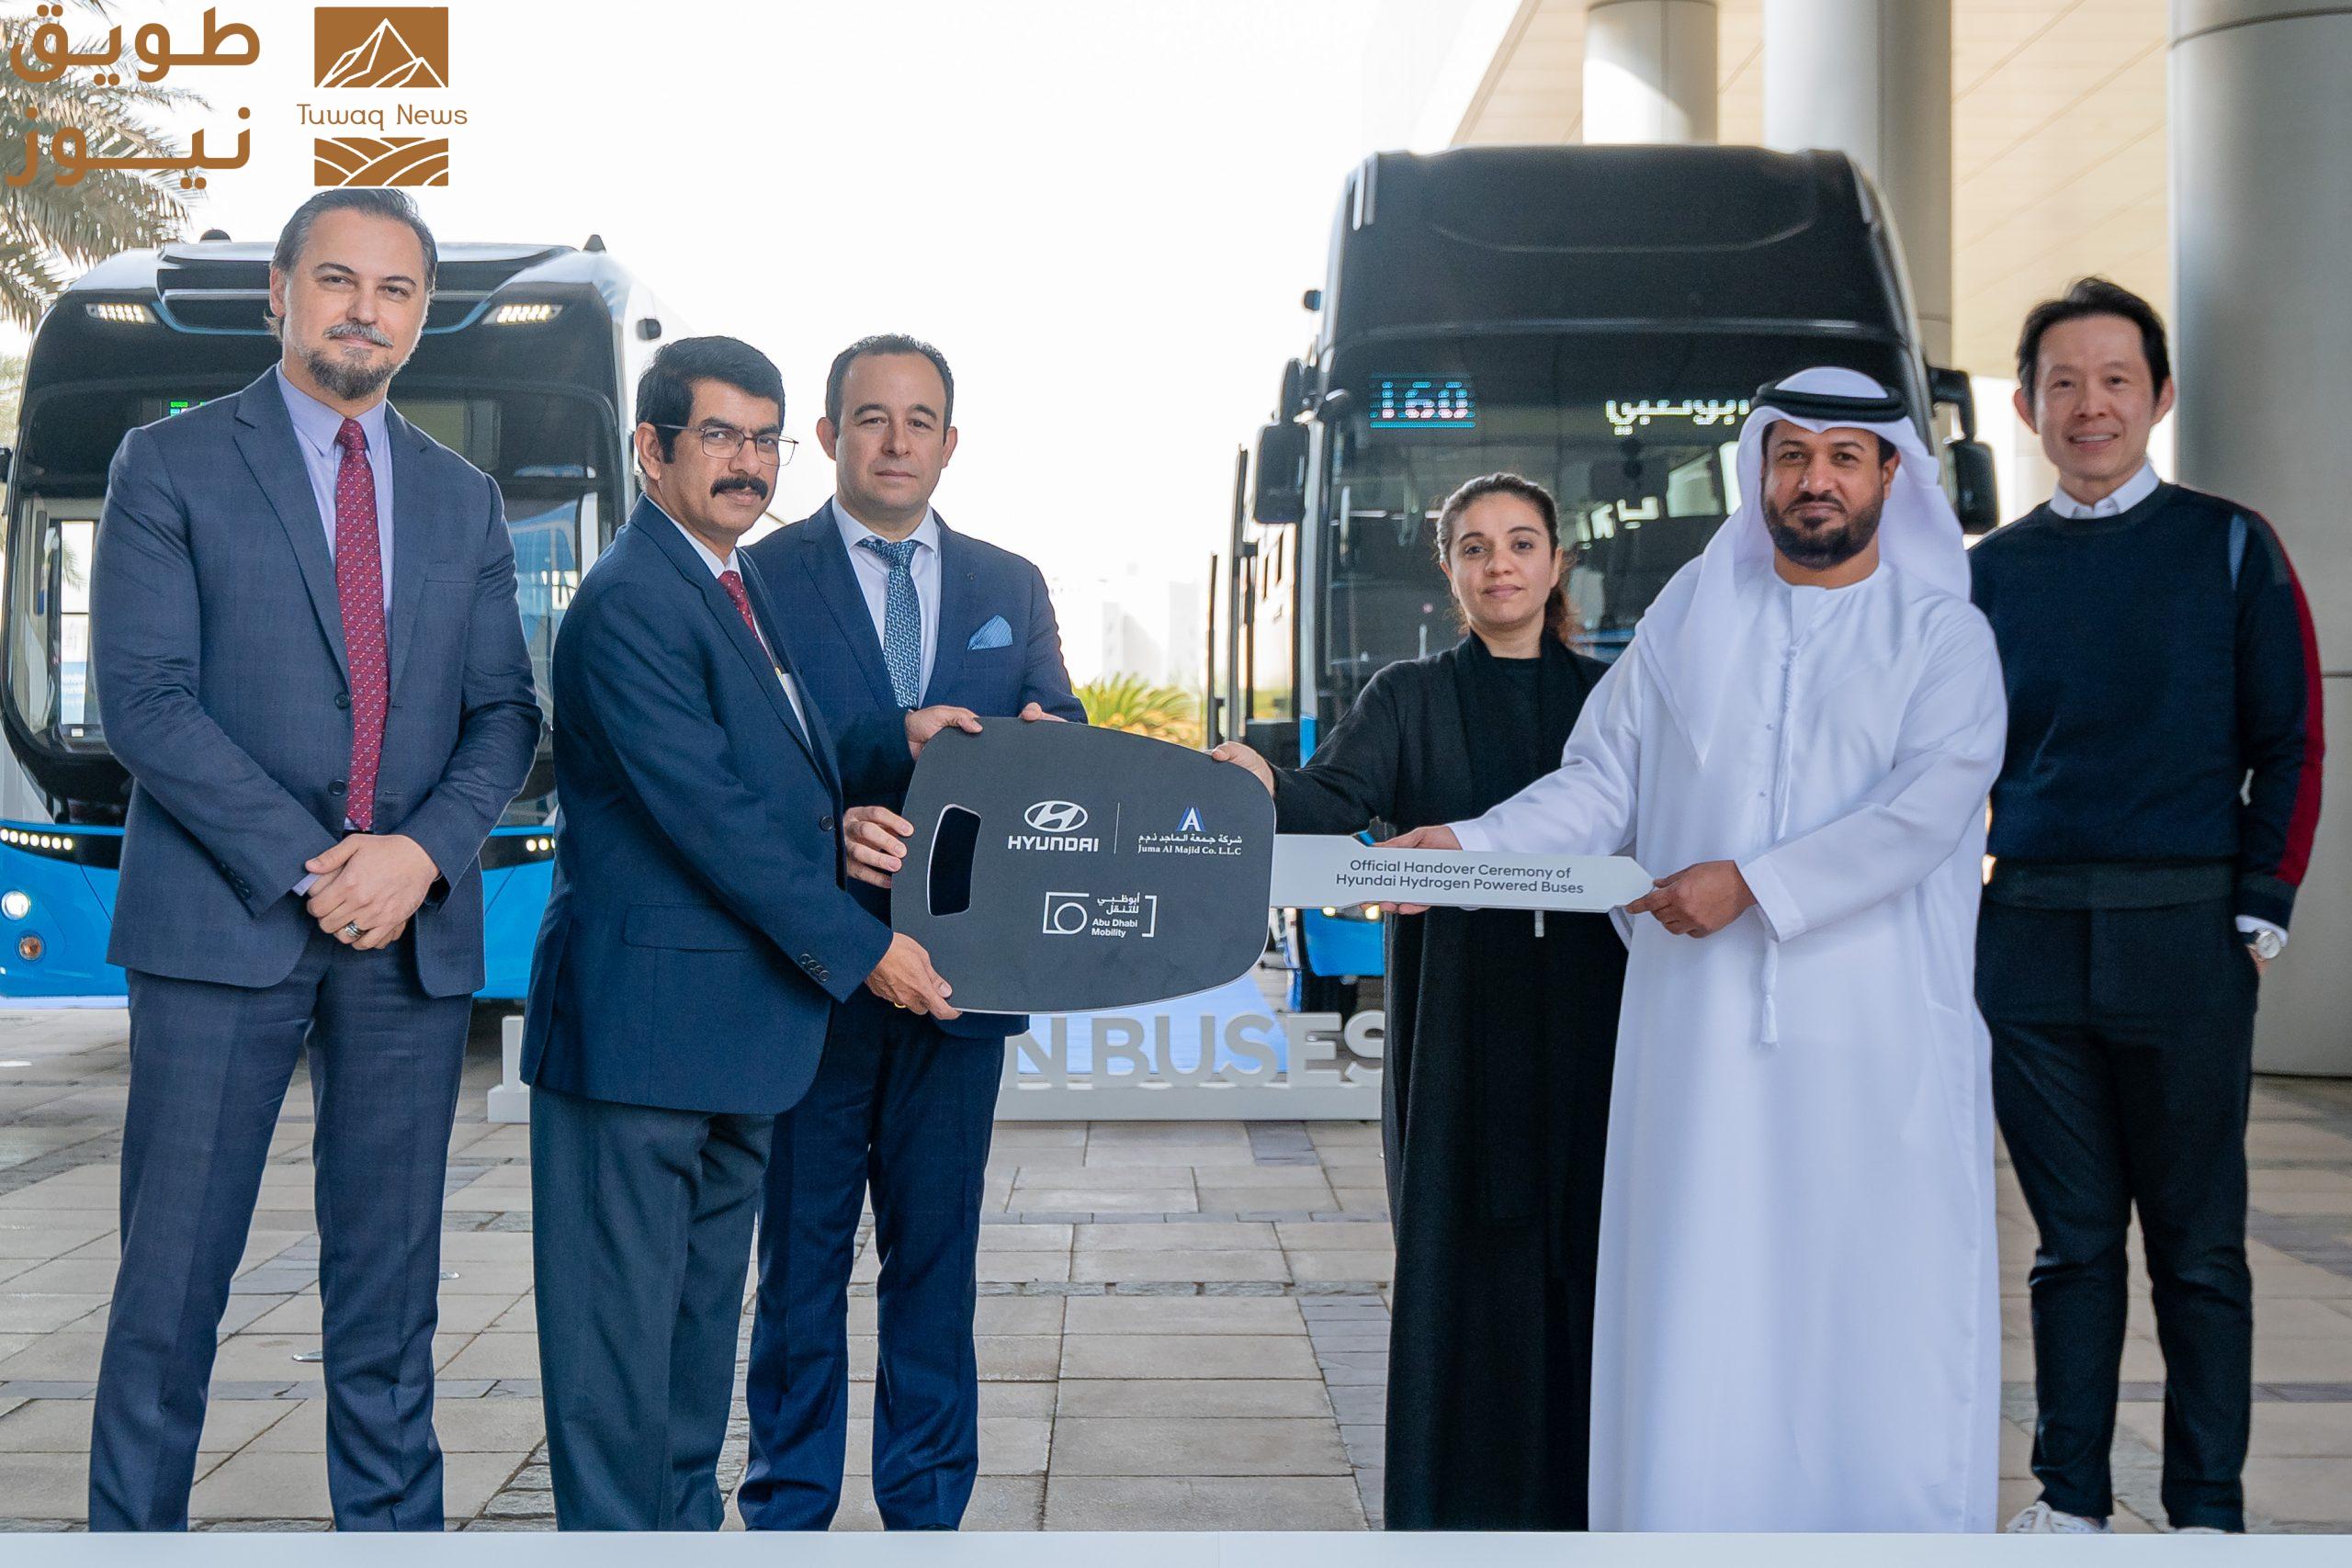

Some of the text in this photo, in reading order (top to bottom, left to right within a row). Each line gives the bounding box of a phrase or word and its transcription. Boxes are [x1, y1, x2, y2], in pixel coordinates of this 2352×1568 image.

[1007, 835, 1100, 852] HYUNDAI
[1159, 833, 1188, 842] الماجد
[1190, 833, 1216, 845] جمعة
[1218, 834, 1242, 846] شركة
[1138, 844, 1160, 854] Juma
[1162, 845, 1172, 853] Al
[1174, 845, 1200, 855] Majid
[1202, 846, 1216, 854] Co.
[1350, 859, 1572, 880] Official Handover Ceremony of
[1336, 873, 1584, 894] Hyundai Hydrogen Powered Buses
[1105, 904, 1139, 915] للتنقل
[1091, 919, 1138, 928] Abu Dhabi
[1091, 928, 1126, 938] Mobility
[1091, 1010, 1385, 1090] BUSES
